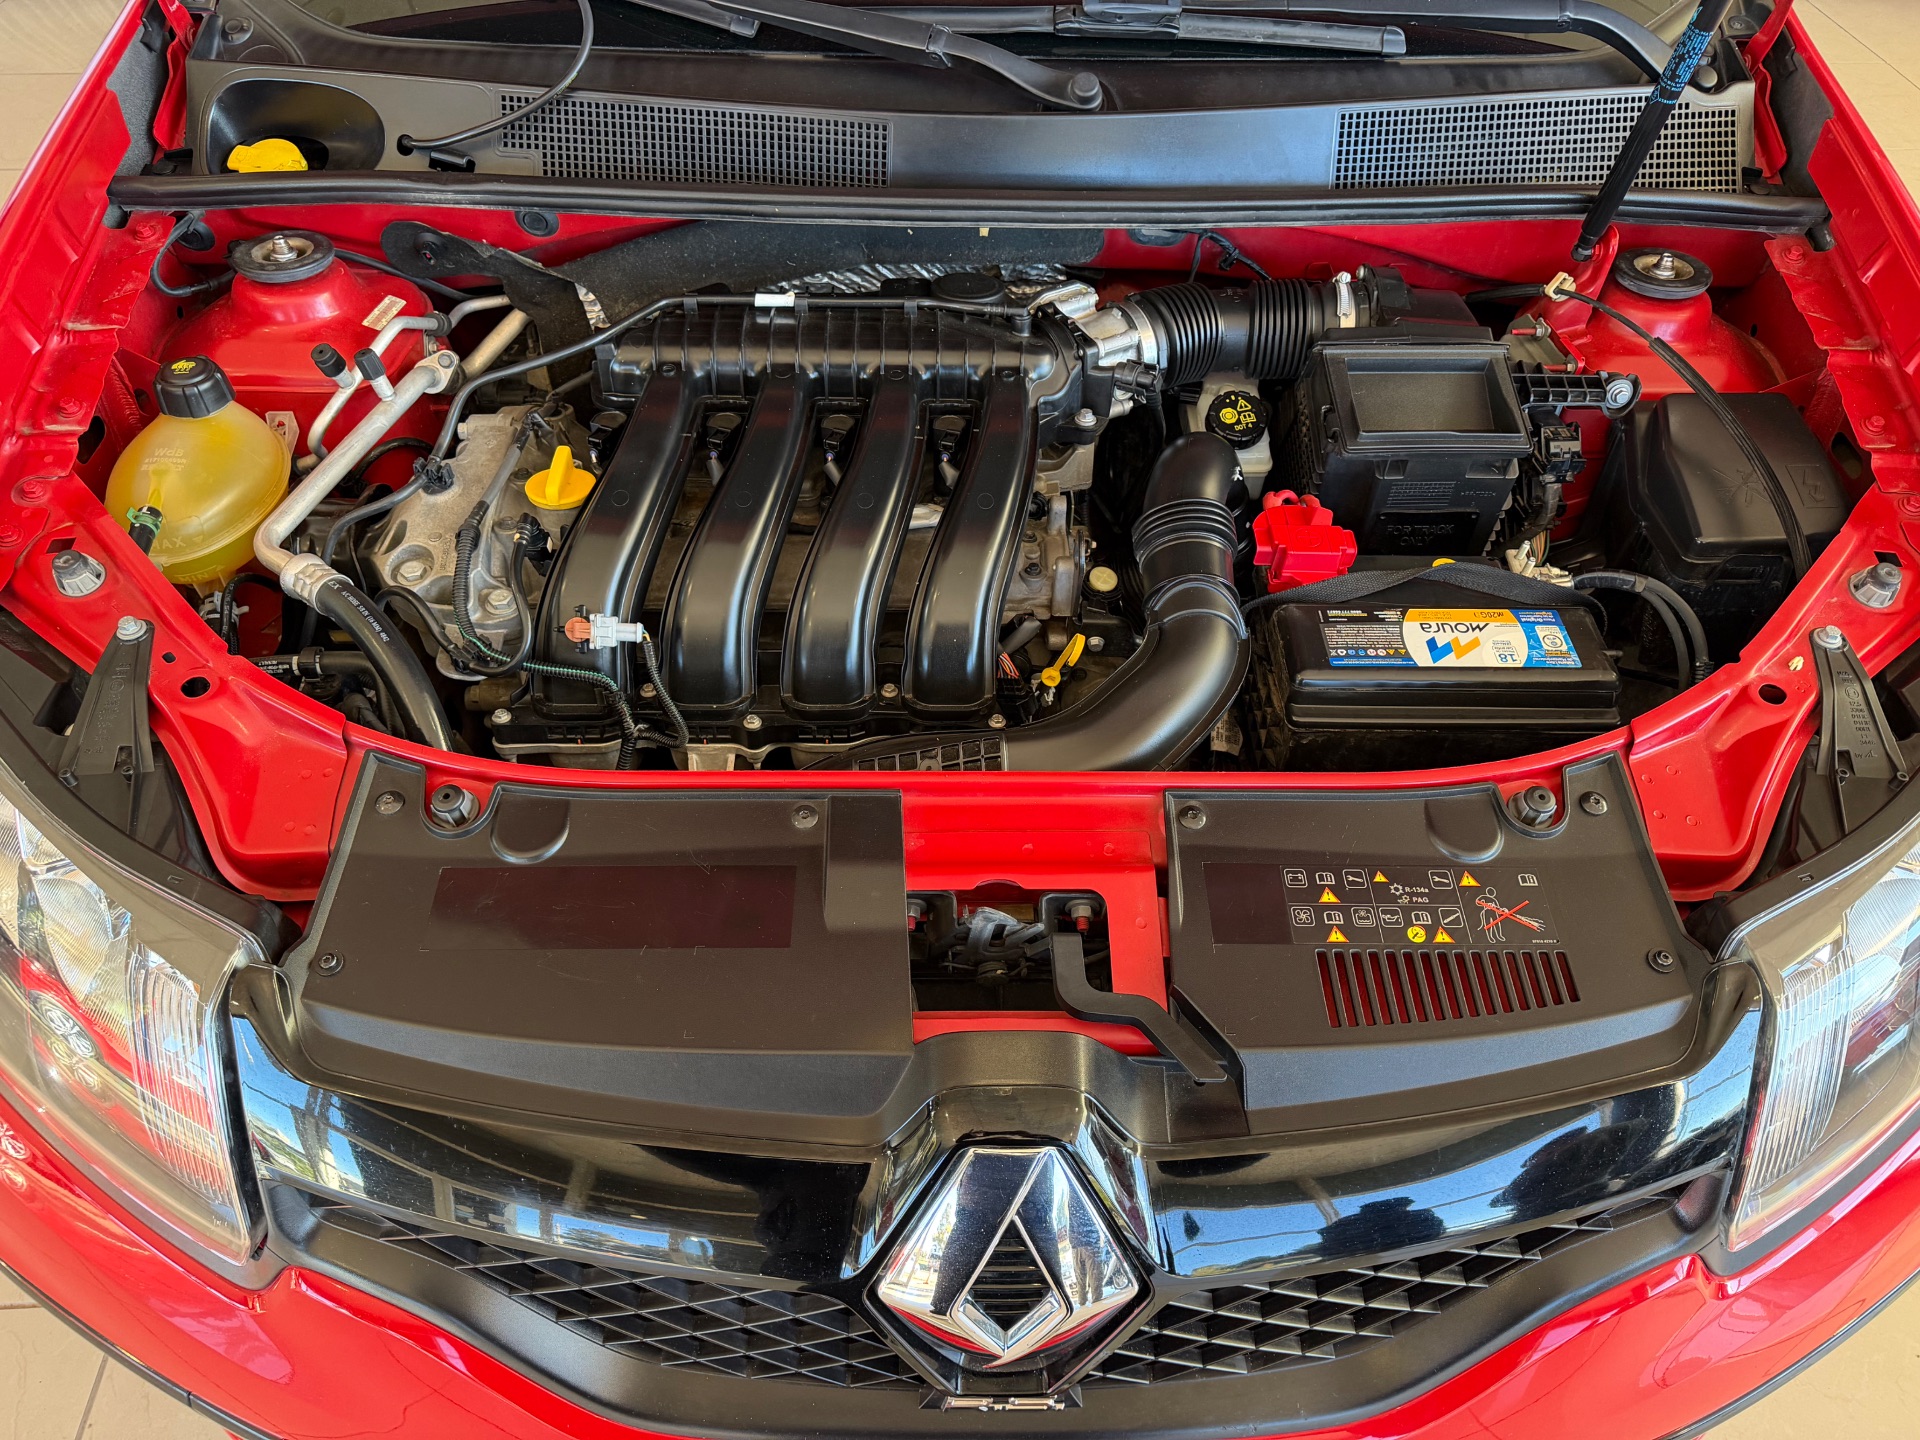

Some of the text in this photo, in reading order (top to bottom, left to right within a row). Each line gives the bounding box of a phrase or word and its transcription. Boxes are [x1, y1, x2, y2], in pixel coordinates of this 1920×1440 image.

[1234, 423, 1247, 431] DOT
[1498, 653, 1518, 663] 18
[1404, 886, 1429, 894] R-134a
[1412, 896, 1429, 904] PAG
